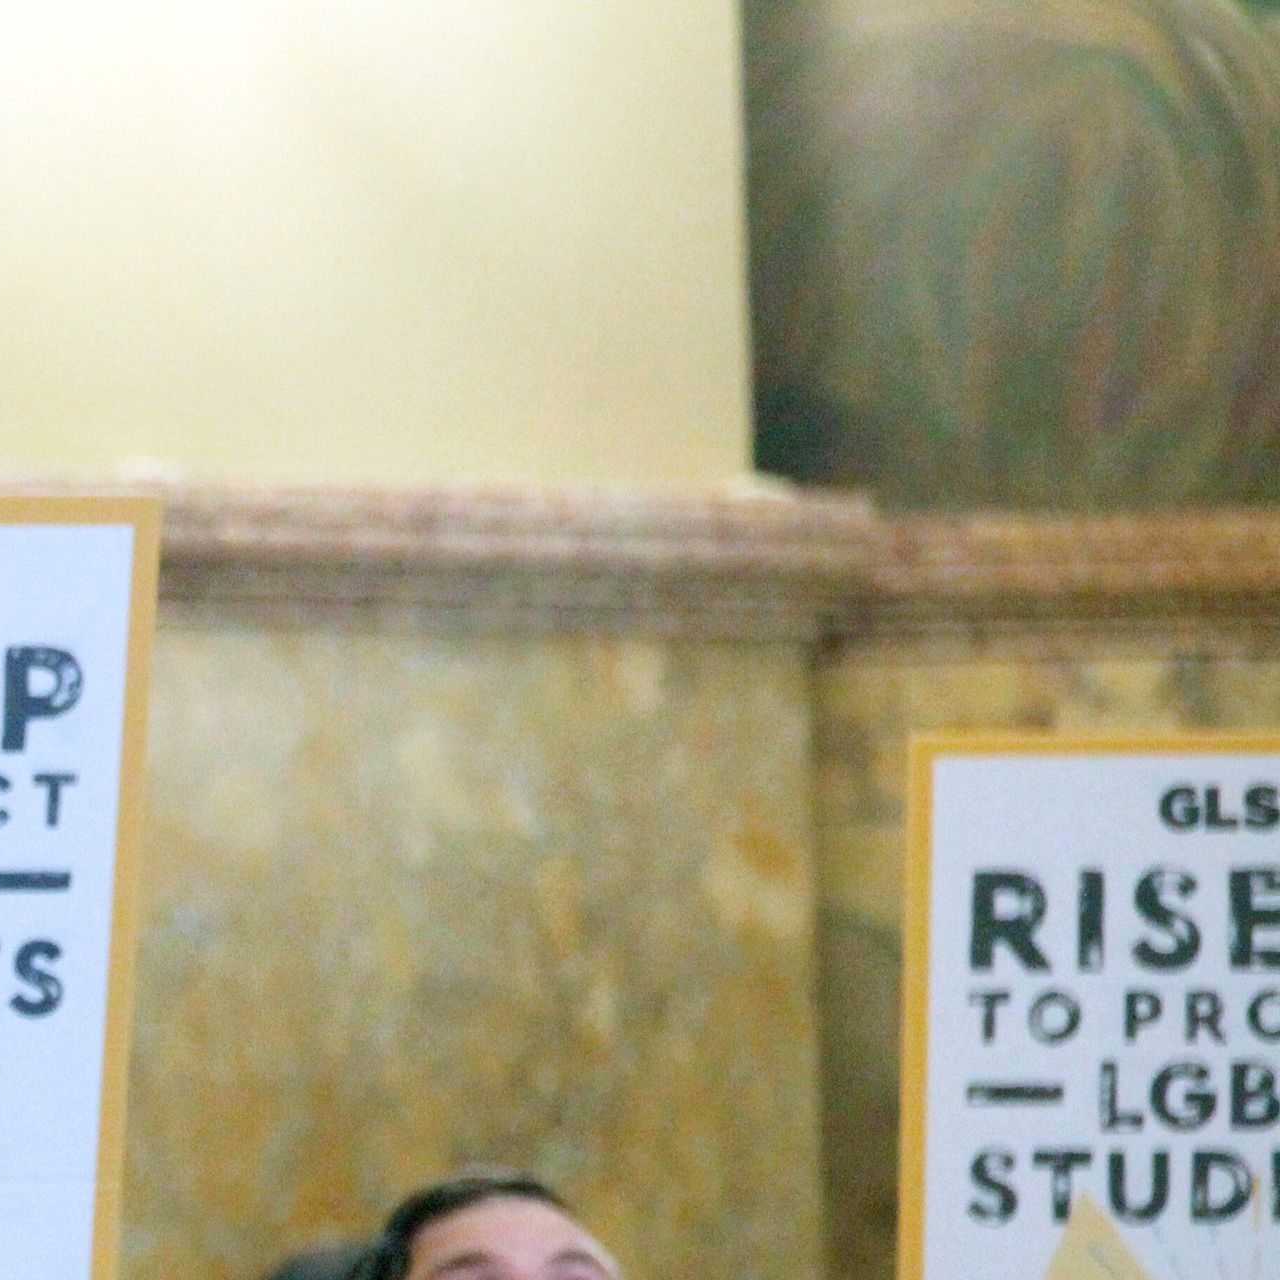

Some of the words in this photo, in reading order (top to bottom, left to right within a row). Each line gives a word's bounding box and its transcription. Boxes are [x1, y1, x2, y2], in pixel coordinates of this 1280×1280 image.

[968, 865, 1280, 973] RISE
[968, 990, 1083, 1046] TO
[966, 1147, 1280, 1227] STUD
